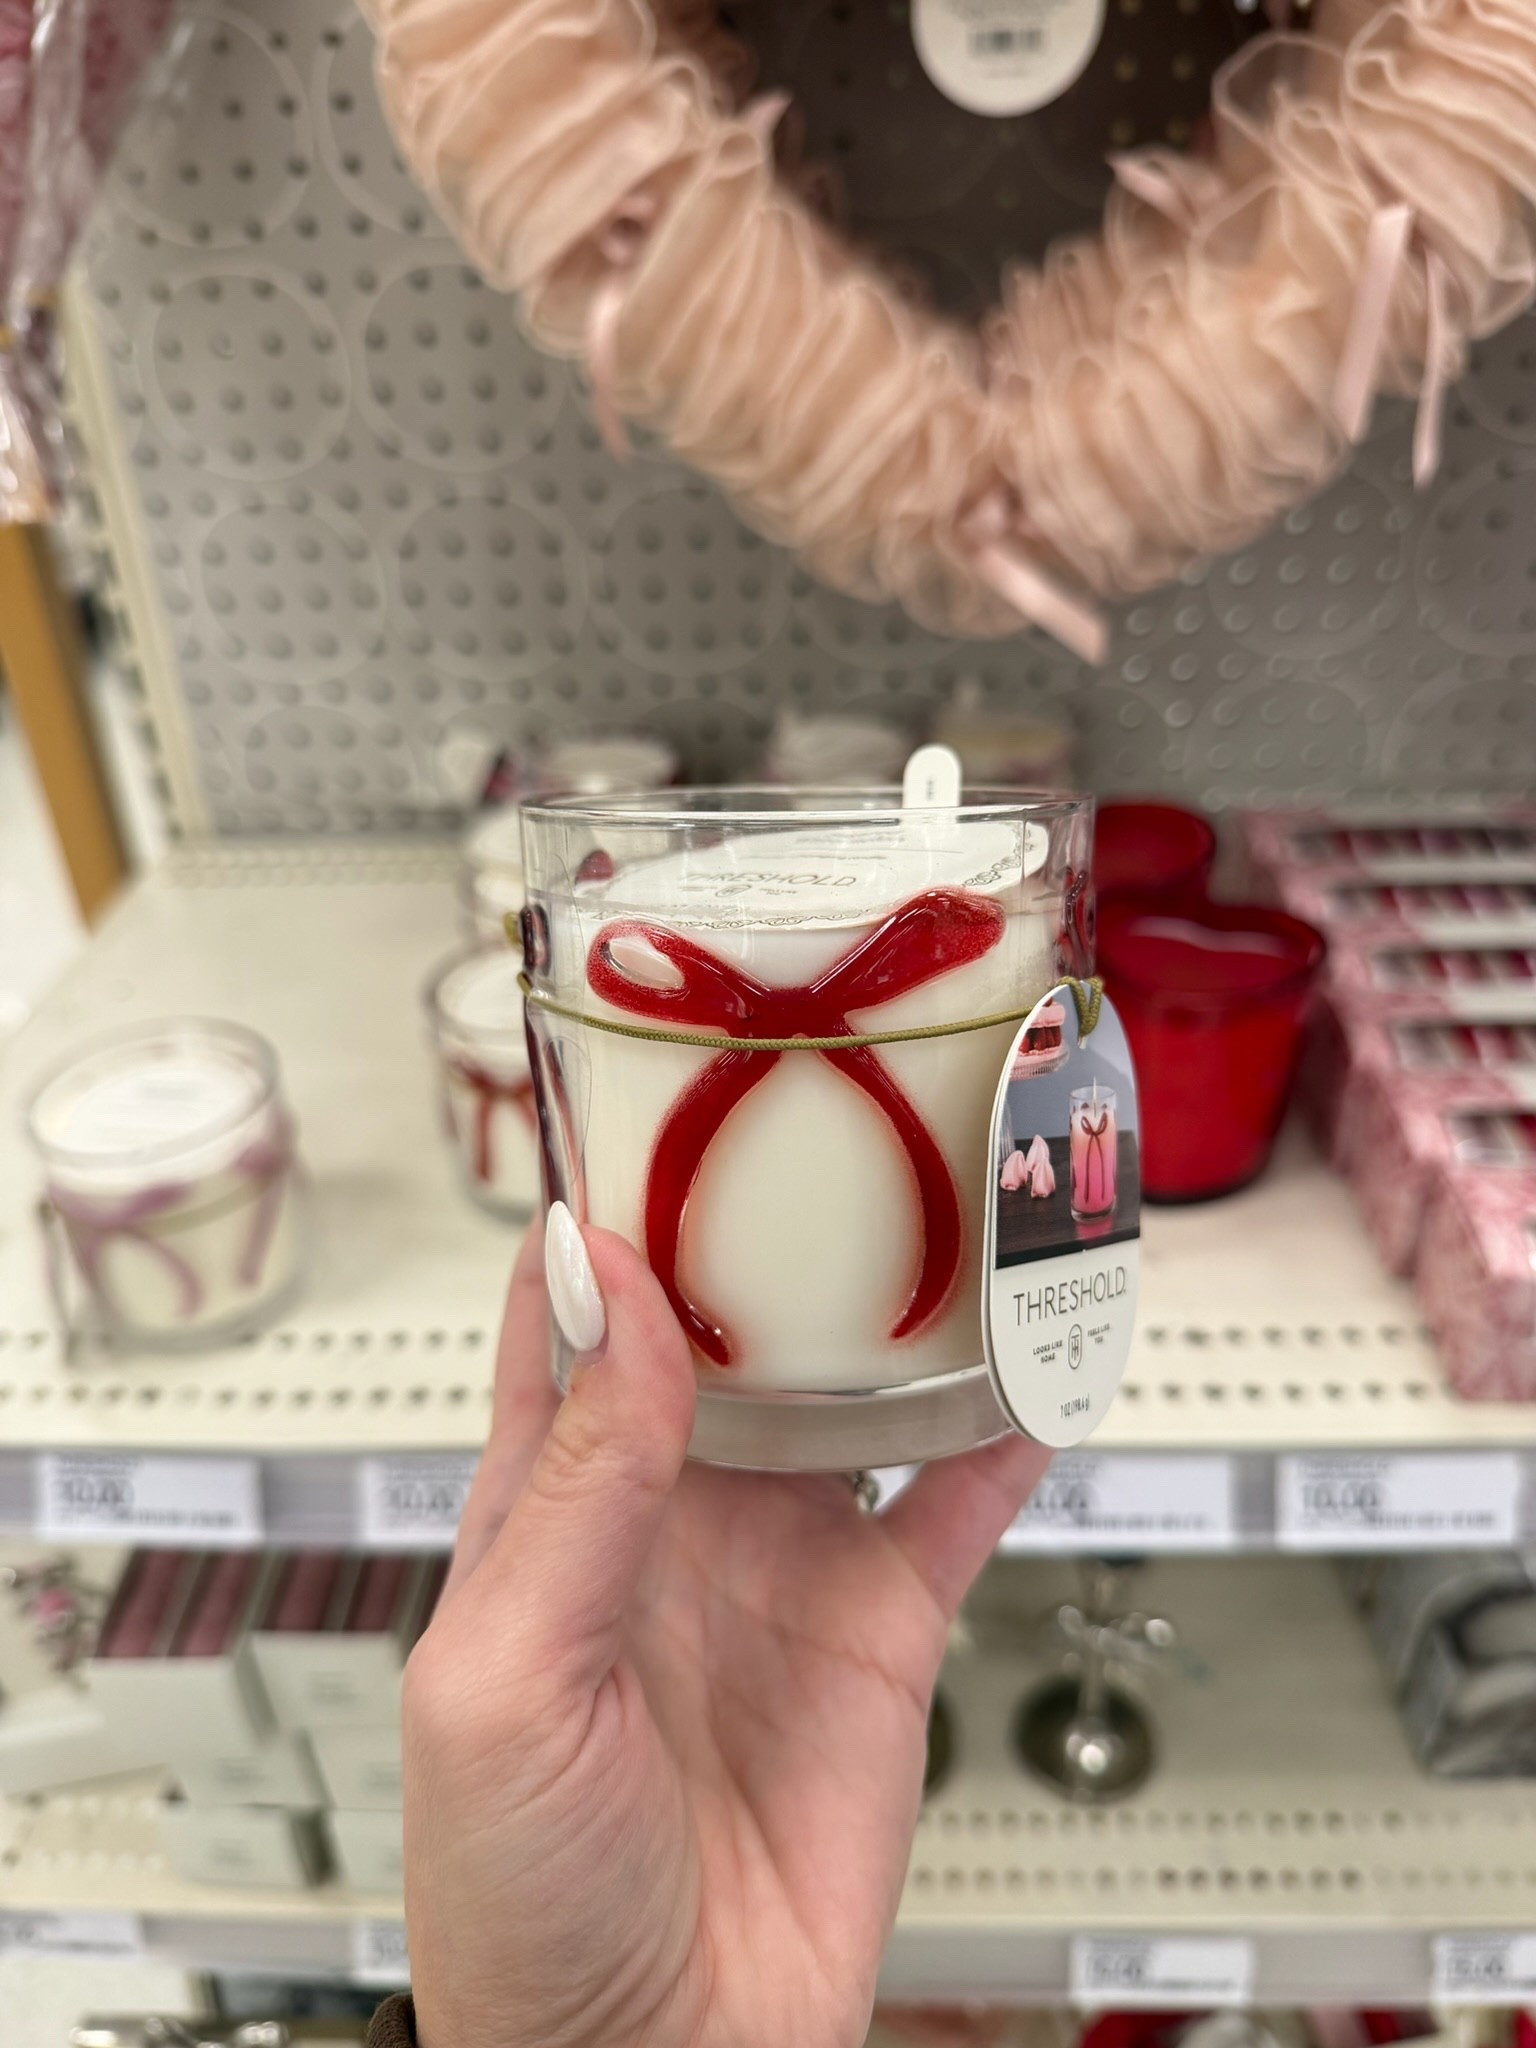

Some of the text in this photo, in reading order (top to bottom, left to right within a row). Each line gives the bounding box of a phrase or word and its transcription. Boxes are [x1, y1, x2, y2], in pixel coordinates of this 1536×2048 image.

[1033, 1339, 1063, 1355] LOOKS LIKE
[1041, 1352, 1055, 1364] HOME
